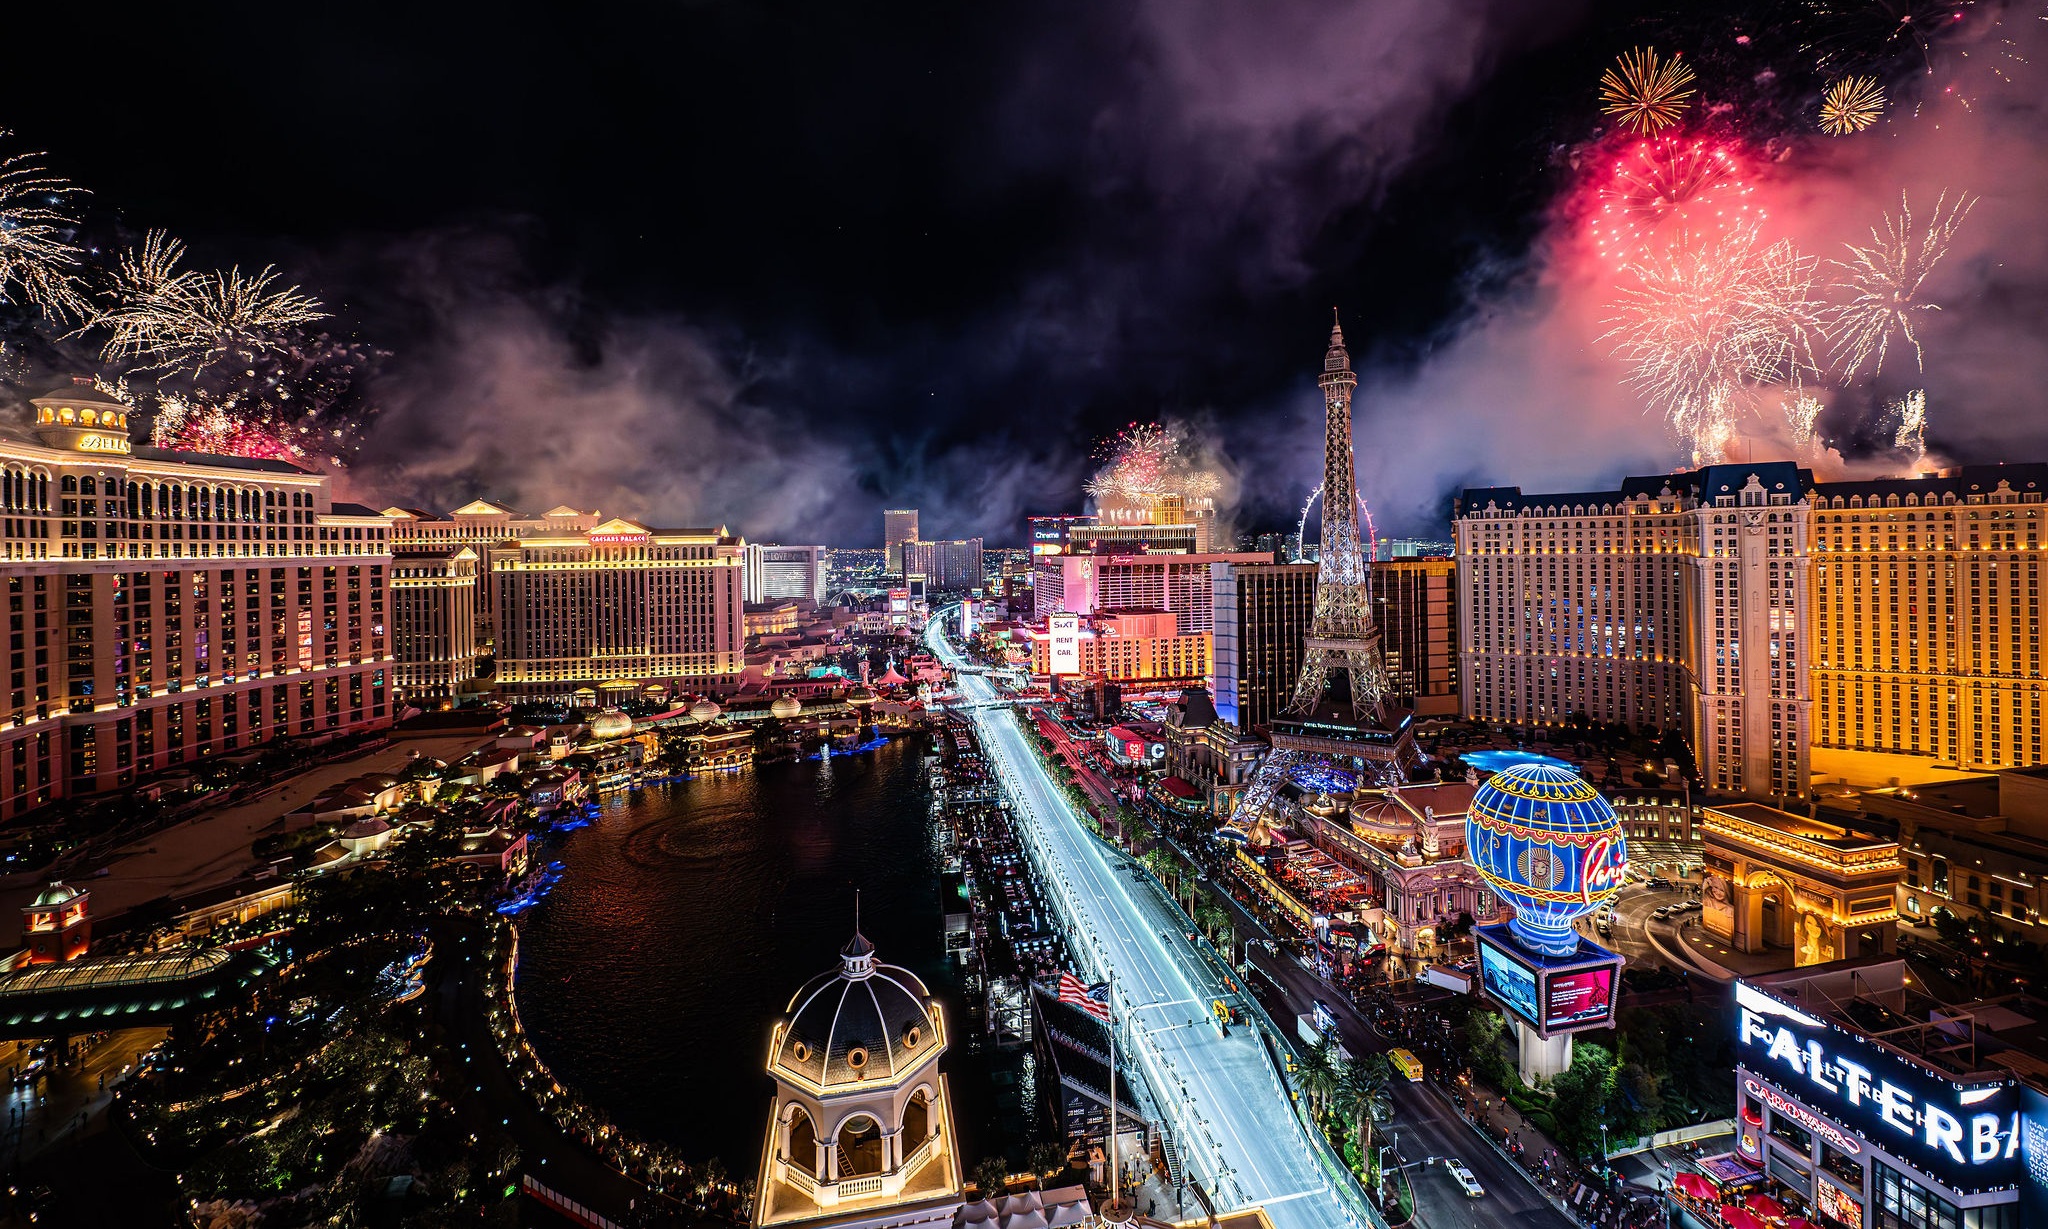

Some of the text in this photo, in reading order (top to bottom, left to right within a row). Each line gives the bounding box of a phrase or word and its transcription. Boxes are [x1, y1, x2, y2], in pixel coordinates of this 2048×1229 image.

[1105, 731, 1120, 753] CVS
[1151, 743, 1165, 759] C
[1582, 837, 1631, 906] Paris
[1744, 1079, 1800, 1119] CABO
[2029, 1125, 2044, 1138] WE
[2029, 1137, 2048, 1152] YOU
